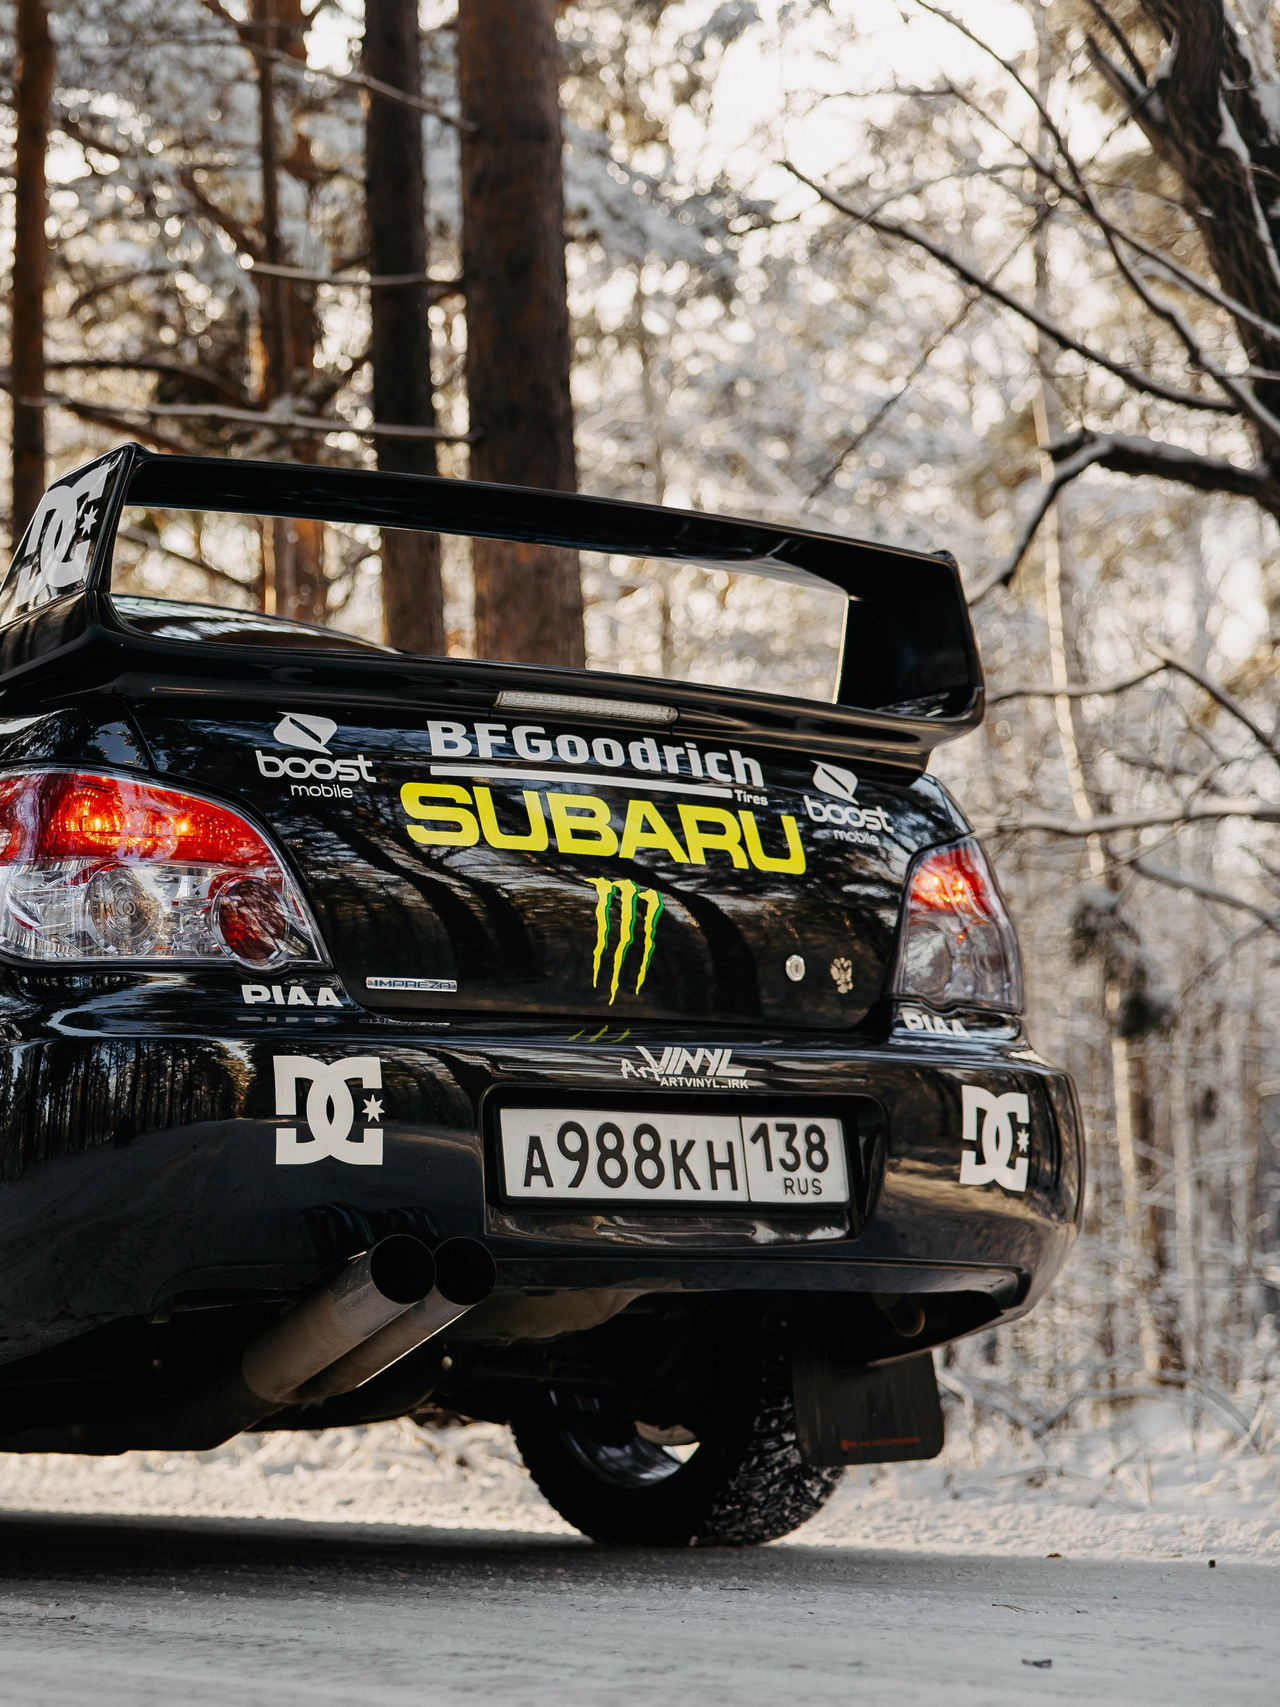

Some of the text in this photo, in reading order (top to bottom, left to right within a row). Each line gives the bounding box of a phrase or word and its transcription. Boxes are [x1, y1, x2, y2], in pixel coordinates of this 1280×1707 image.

[255, 750, 377, 783] boost
[426, 720, 765, 788] BFGoodrich
[290, 784, 354, 798] mobile
[733, 789, 769, 806] Tires
[400, 782, 807, 875] SUBARU
[803, 795, 895, 834] boost
[833, 829, 880, 846] mobile
[241, 984, 344, 1008] PIAA
[374, 979, 451, 990] IMPREZA
[901, 1010, 970, 1038] PIAA
[635, 1046, 748, 1077] VINYL
[660, 1077, 750, 1089] ARTVINYL_IRK
[273, 1055, 384, 1166] DC
[959, 1084, 1030, 1193] DC
[523, 1120, 830, 1192] A988KH 138
[783, 1178, 823, 1196] RUS
